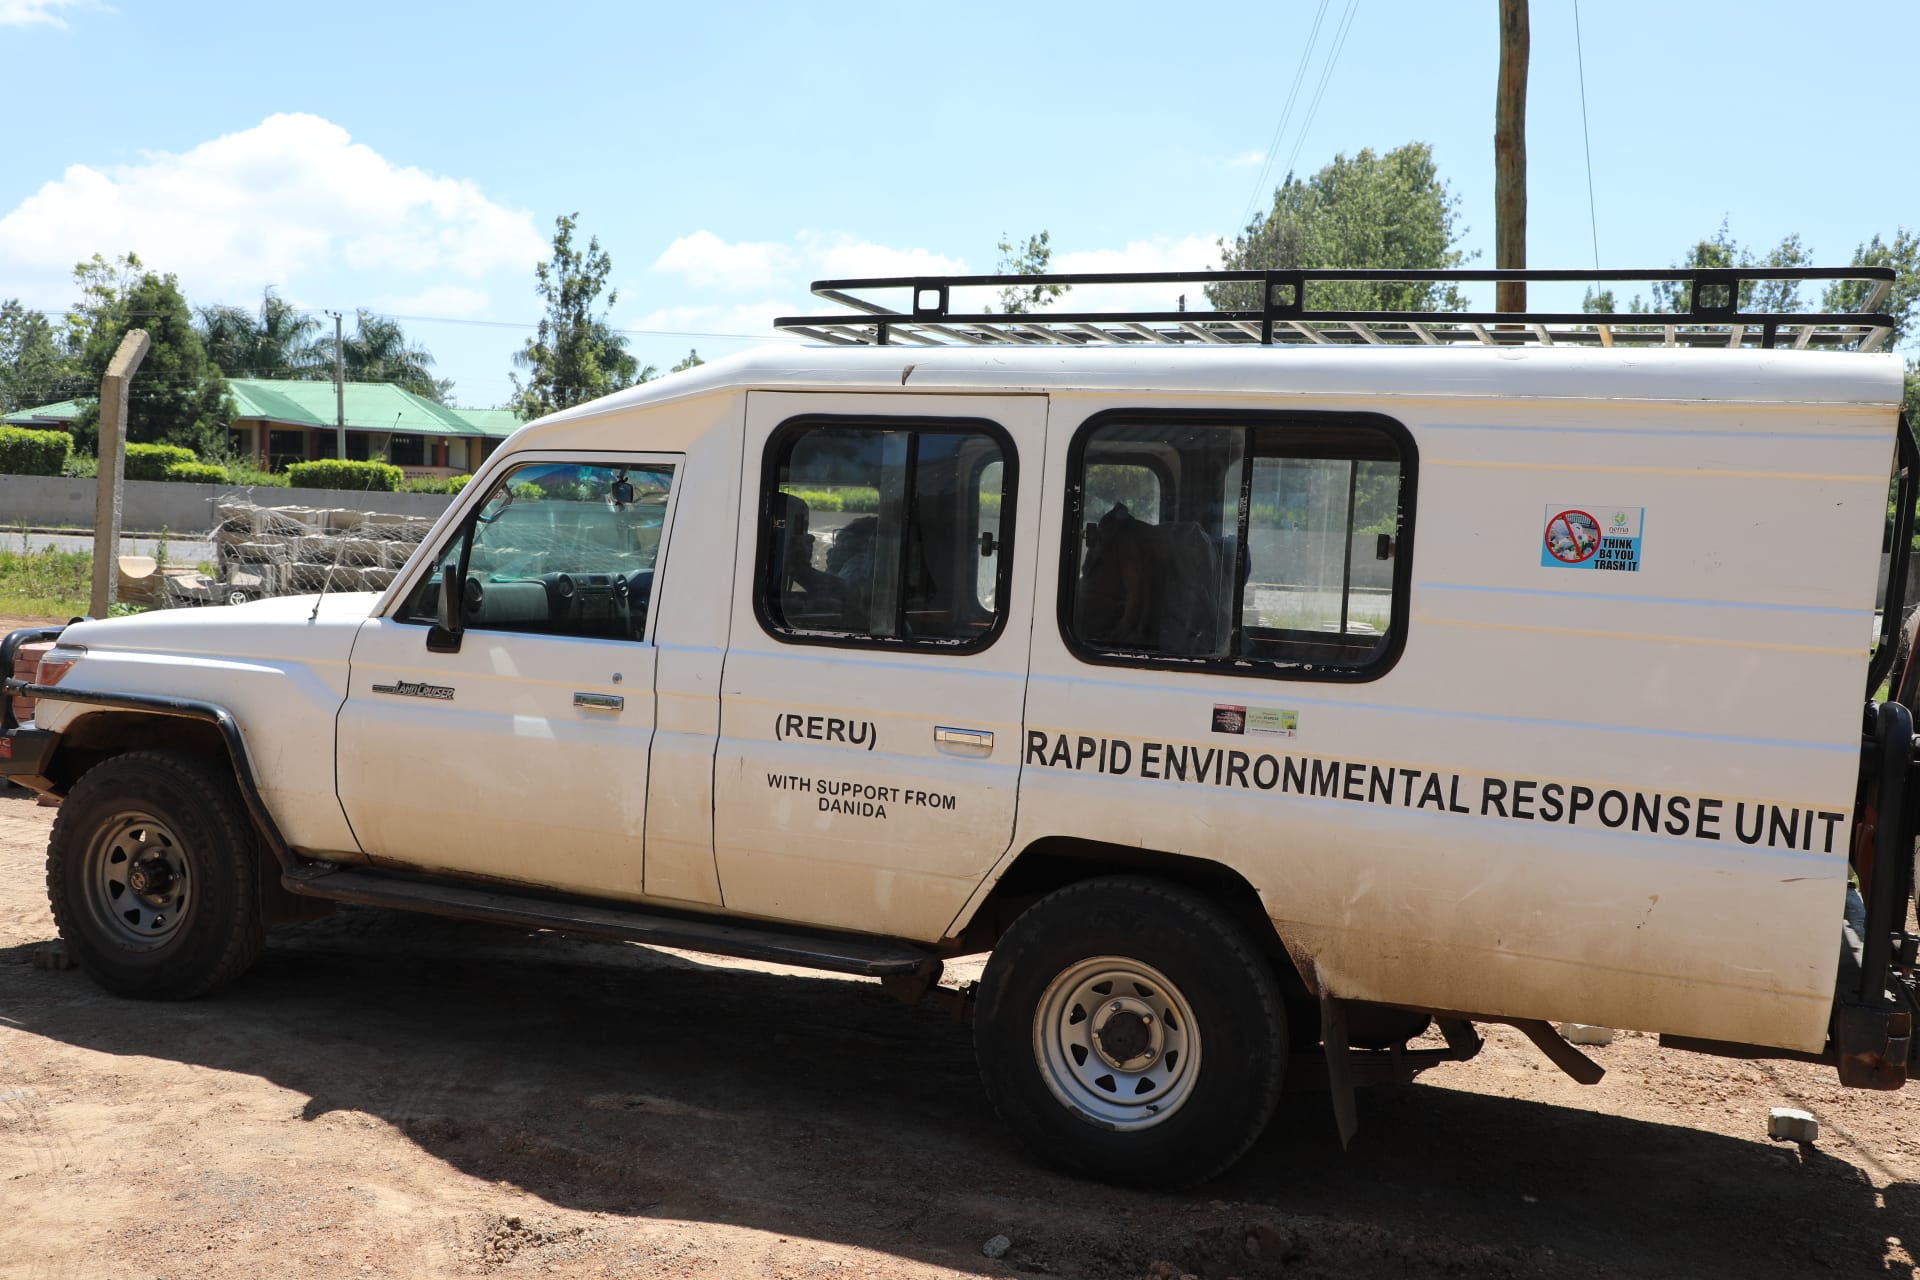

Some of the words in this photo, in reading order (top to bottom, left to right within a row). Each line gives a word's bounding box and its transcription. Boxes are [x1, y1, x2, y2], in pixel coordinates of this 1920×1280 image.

[1599, 548, 1612, 560] B4
[1614, 549, 1634, 560] YOU
[1602, 538, 1633, 549] THINK
[1594, 559, 1626, 571] TRASH
[1627, 561, 1638, 572] IT
[775, 713, 877, 751] (RERU)
[767, 773, 811, 793] WITH
[816, 779, 900, 803] SUPPORT
[904, 789, 956, 811] FROM
[1025, 730, 1132, 775] RAPID
[1140, 742, 1470, 814] ENVIRONMENTAL
[1480, 777, 1723, 841] RESPONSE
[1735, 802, 1845, 854] UNIT
[818, 797, 887, 819] DANIDA
